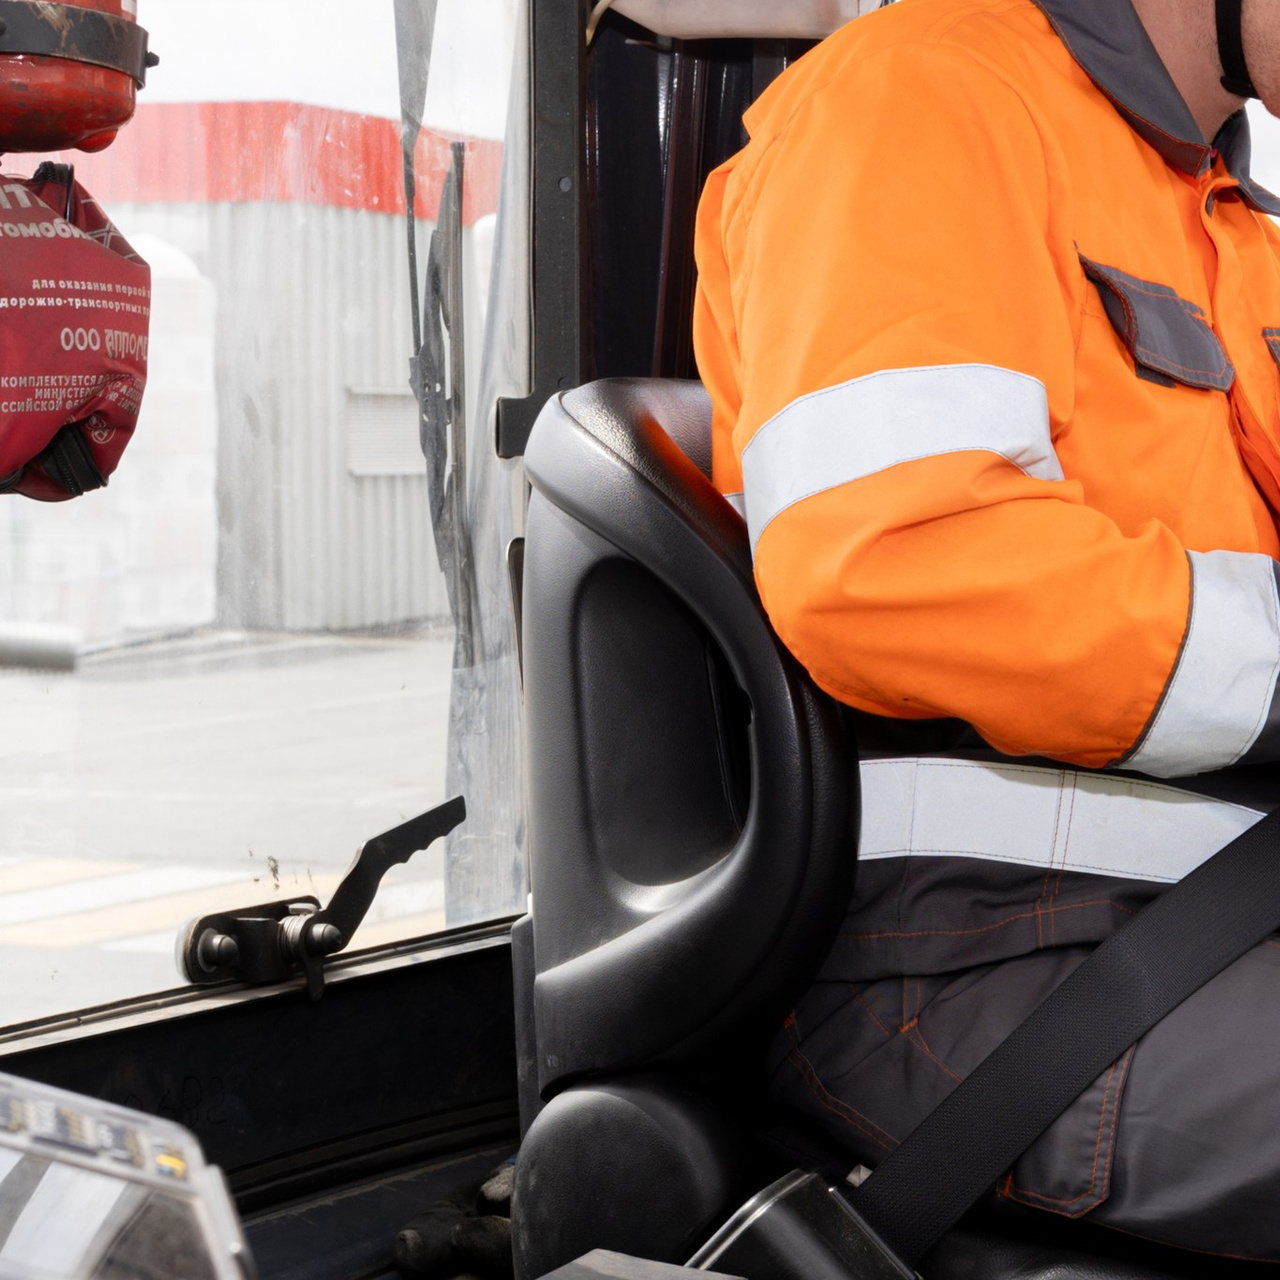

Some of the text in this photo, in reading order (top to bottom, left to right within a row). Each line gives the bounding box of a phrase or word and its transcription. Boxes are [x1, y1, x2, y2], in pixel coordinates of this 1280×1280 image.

[32, 279, 56, 290] для
[58, 280, 113, 292] оказания
[115, 283, 147, 298] первой
[0, 297, 142, 314] дорожно-транспортных
[60, 327, 101, 351] ООО
[1, 375, 97, 388] КОМПЛЕКТУЕТСЯ
